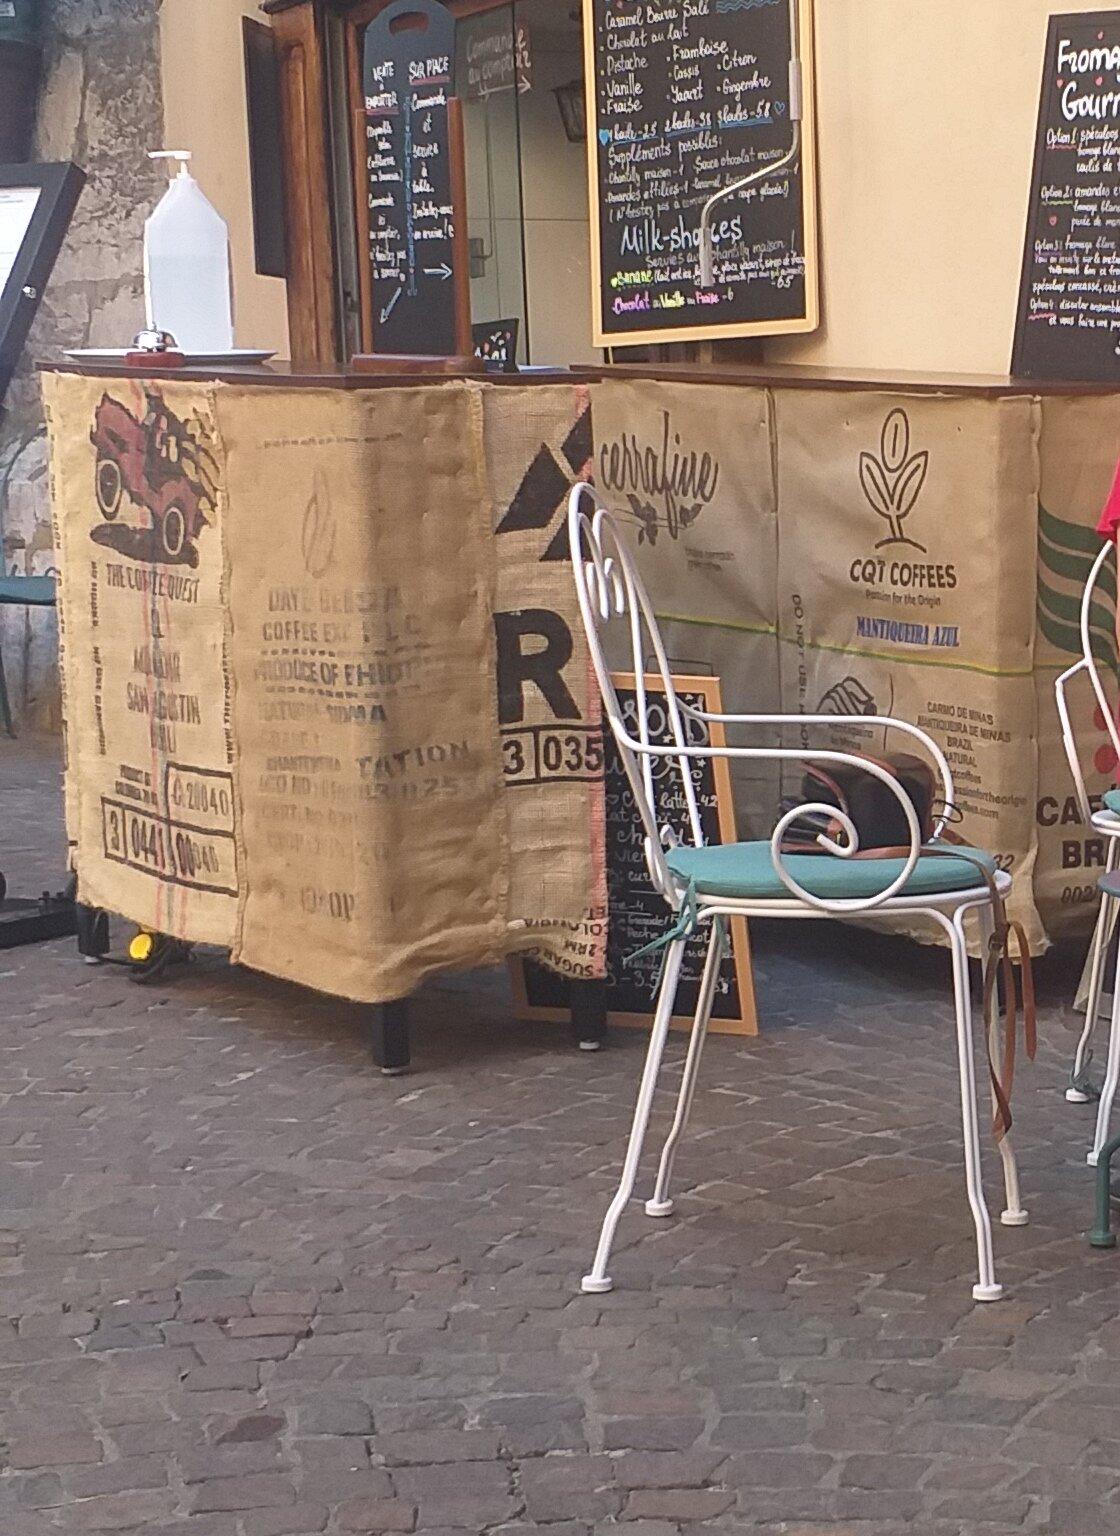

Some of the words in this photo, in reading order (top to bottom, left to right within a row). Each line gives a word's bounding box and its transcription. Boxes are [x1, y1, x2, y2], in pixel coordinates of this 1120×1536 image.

[605, 6, 643, 30] Caramel
[651, 32, 664, 43] au
[672, 37, 728, 61] Framboise
[606, 52, 648, 76] Pistache
[722, 50, 757, 71] Citron
[606, 72, 643, 96] Vanille
[673, 66, 700, 82] Cassis
[722, 71, 771, 101] Gingembre
[606, 97, 643, 116] Fraise
[1046, 127, 1071, 149] Option
[608, 137, 672, 168] Suppléments
[106, 563, 126, 588] THE
[168, 575, 200, 603] QUEST
[849, 558, 886, 585] CQT
[890, 562, 957, 589] COFFEES
[892, 589, 904, 605] for
[904, 591, 916, 606] the
[918, 593, 941, 609] Origin
[856, 616, 930, 645] MANTIQUEIRA
[932, 626, 961, 648] AZUL
[493, 608, 583, 724] R
[927, 701, 956, 719] CARMO
[957, 706, 968, 720] DE
[969, 708, 994, 725] MINAS
[946, 735, 973, 752] BRAZIL
[969, 724, 980, 737] DE
[980, 727, 1011, 743] MINAS
[502, 739, 525, 775] 3
[110, 810, 120, 852] 3
